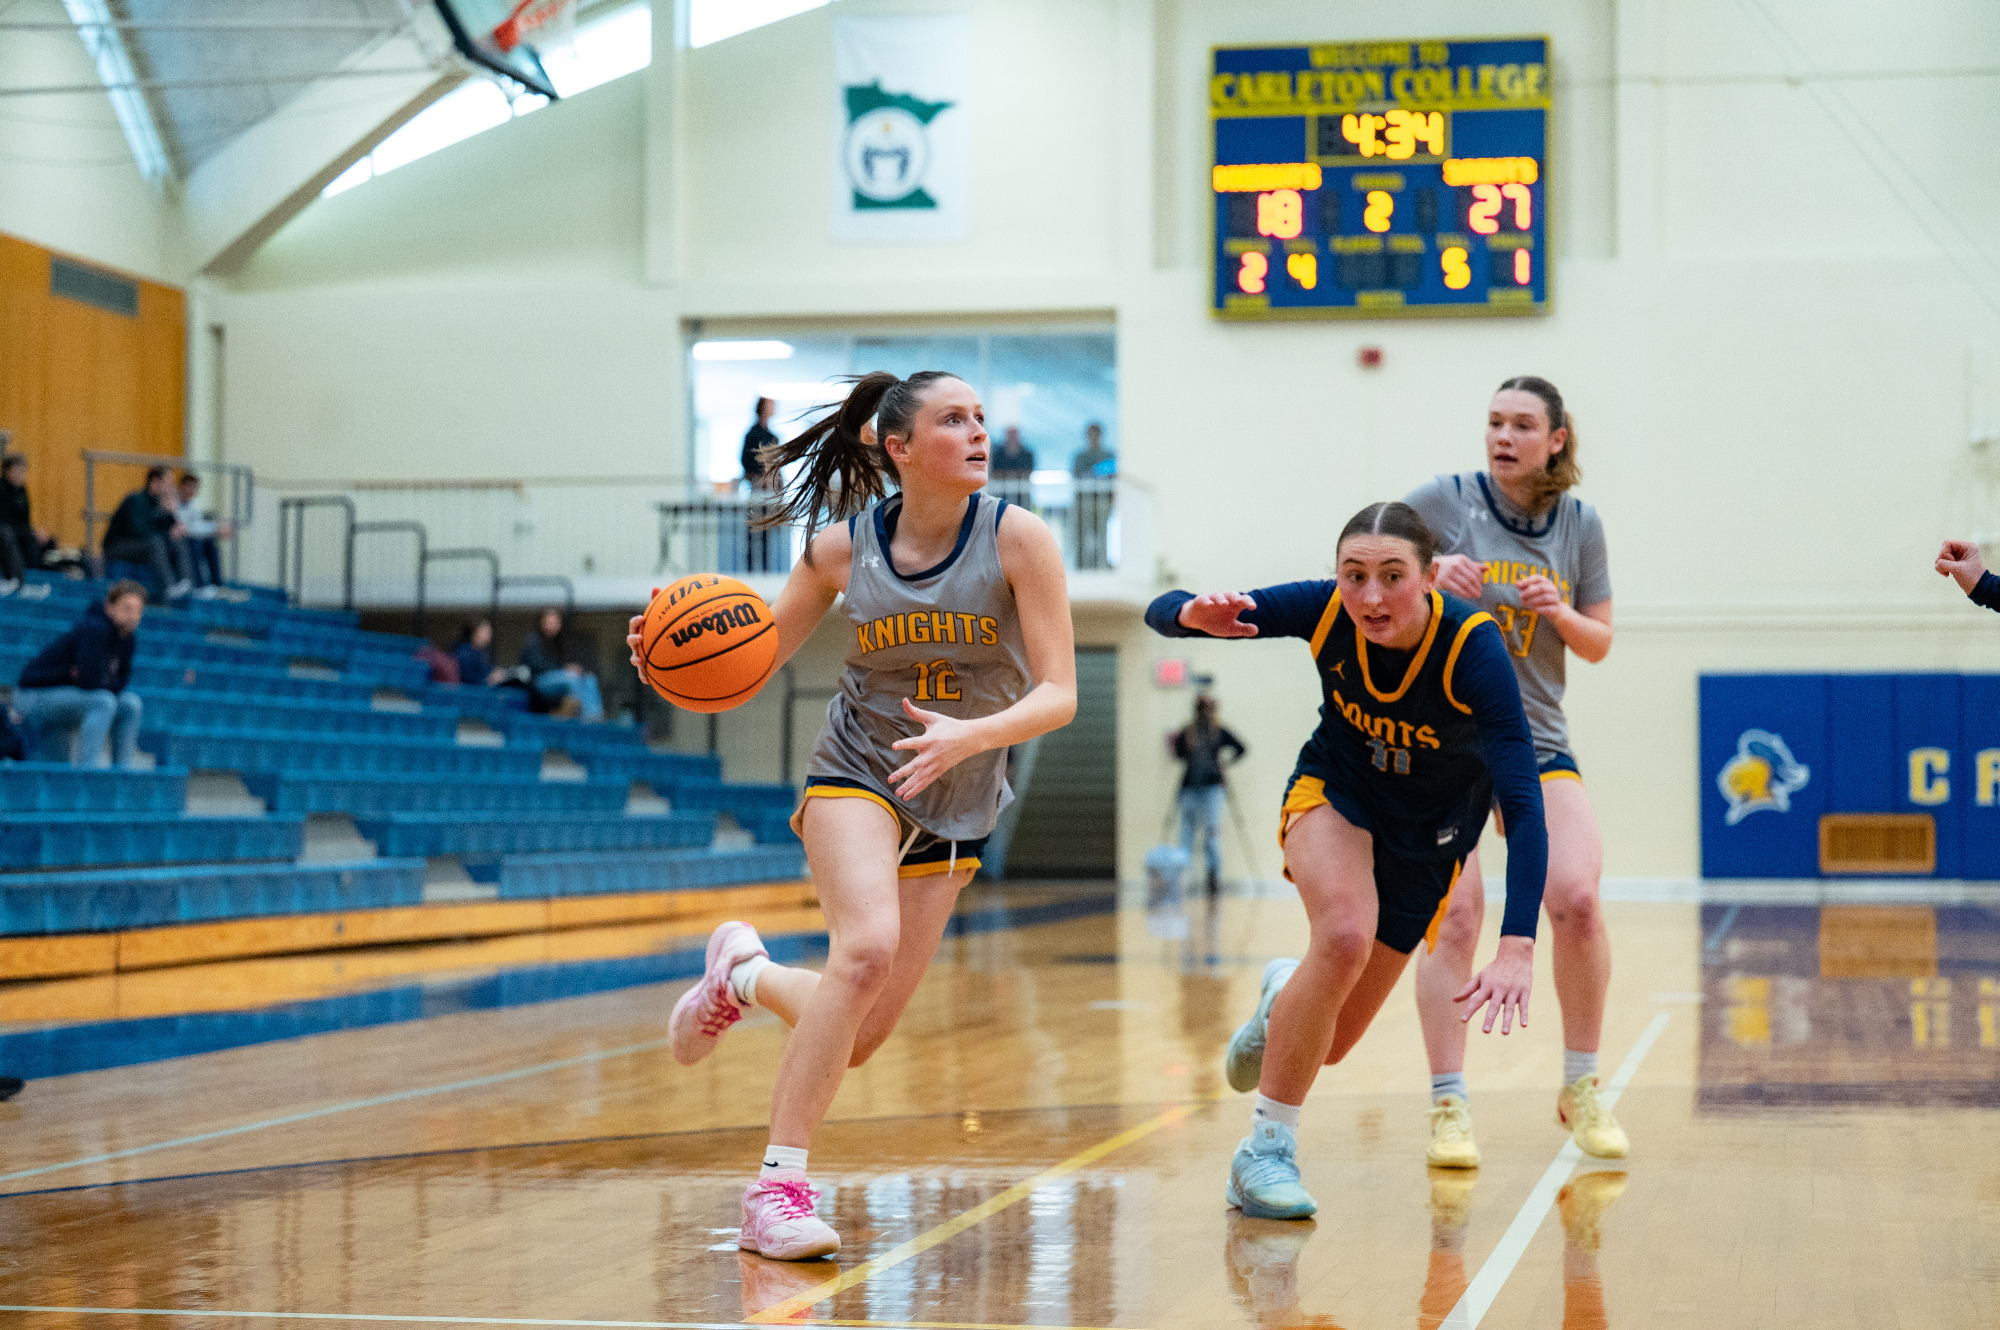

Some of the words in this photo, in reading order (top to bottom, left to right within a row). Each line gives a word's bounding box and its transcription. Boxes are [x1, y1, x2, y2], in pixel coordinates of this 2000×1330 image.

[1392, 65, 1547, 101] COLLEGE
[1342, 109, 1444, 160] 4:34
[1257, 188, 1303, 239] 18
[1364, 190, 1394, 232] 2
[1469, 183, 1531, 234] 27
[1238, 251, 1268, 294] 2
[1287, 253, 1317, 290] 4
[1441, 246, 1471, 289] 5
[669, 577, 719, 606] EVO
[1483, 560, 1570, 606] NIGTS
[668, 602, 761, 648] Wilson
[857, 610, 998, 655] KNIGHTS
[911, 659, 962, 700] 12
[1365, 736, 1411, 775] 11
